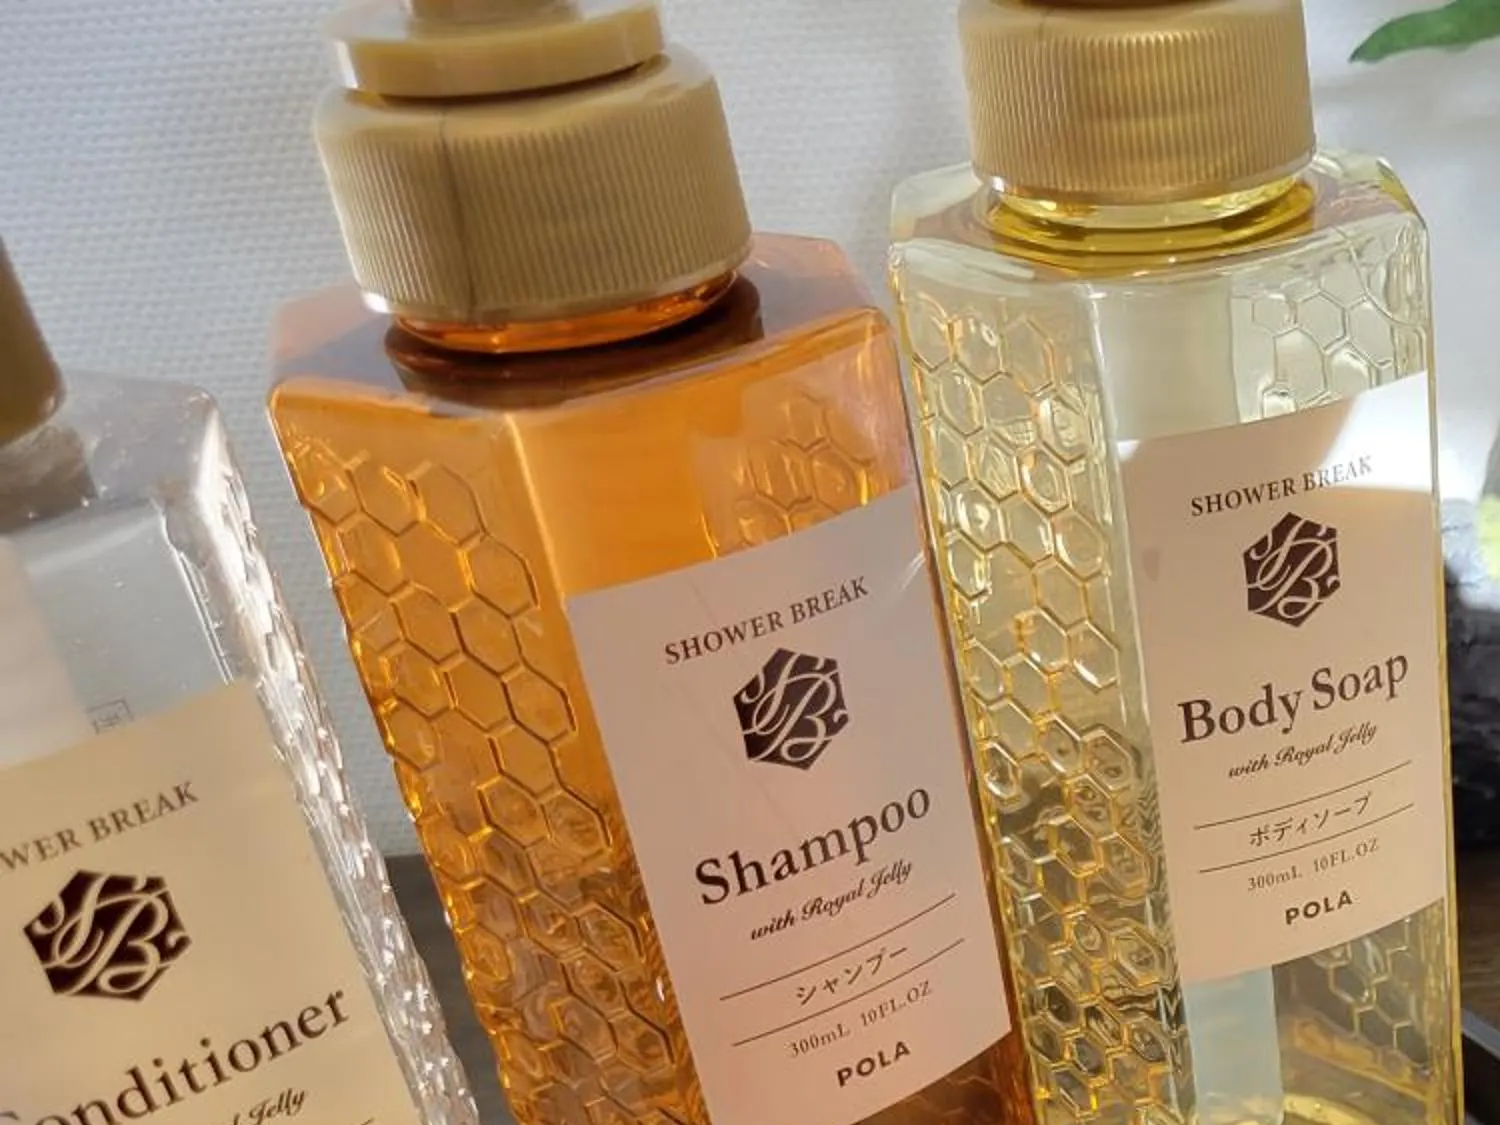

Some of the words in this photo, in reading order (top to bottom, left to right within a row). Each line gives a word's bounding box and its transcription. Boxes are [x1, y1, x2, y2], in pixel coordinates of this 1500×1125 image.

[1190, 477, 1297, 517] SHOWER
[1303, 455, 1372, 491] BREAK
[664, 612, 784, 664] SHOWER
[790, 576, 869, 624] BREAK
[1177, 683, 1303, 744] Body
[1311, 654, 1408, 711] Soap
[1228, 754, 1269, 779] with
[1274, 736, 1333, 767] Royal
[1333, 721, 1377, 755] Jelly
[88, 781, 199, 842] BREAK
[1249, 791, 1373, 847] ボディソープ
[695, 788, 930, 905] Shampoo
[750, 910, 796, 940] with
[801, 880, 865, 921] Royal
[866, 858, 912, 899] Jelly
[1248, 865, 1302, 892] 300mL
[1285, 890, 1353, 925] POLA
[796, 946, 908, 1006] シャンプー
[789, 1022, 849, 1057] 300mL
[837, 1040, 911, 1087] POLA
